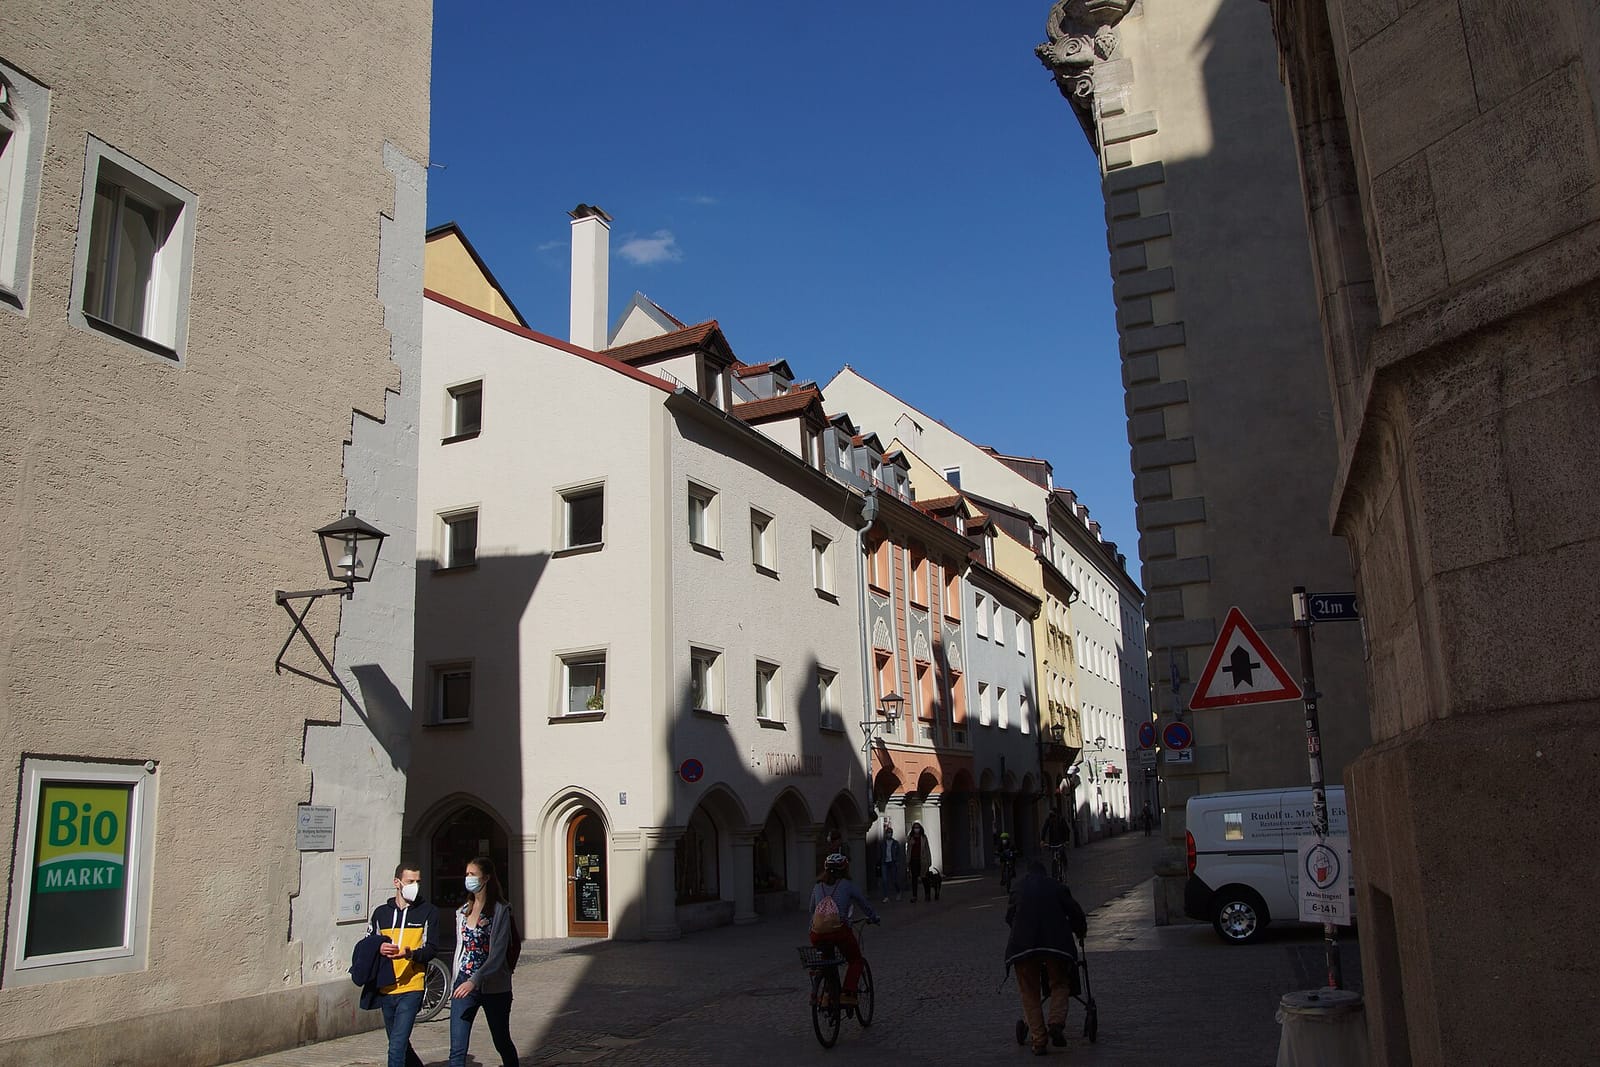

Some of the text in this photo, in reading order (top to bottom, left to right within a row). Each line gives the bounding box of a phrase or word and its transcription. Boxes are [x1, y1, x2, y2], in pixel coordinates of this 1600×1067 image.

[1315, 600, 1344, 614] Am
[48, 800, 119, 847] Bio
[1251, 811, 1282, 821] Rudolf
[45, 866, 115, 888] MARKT
